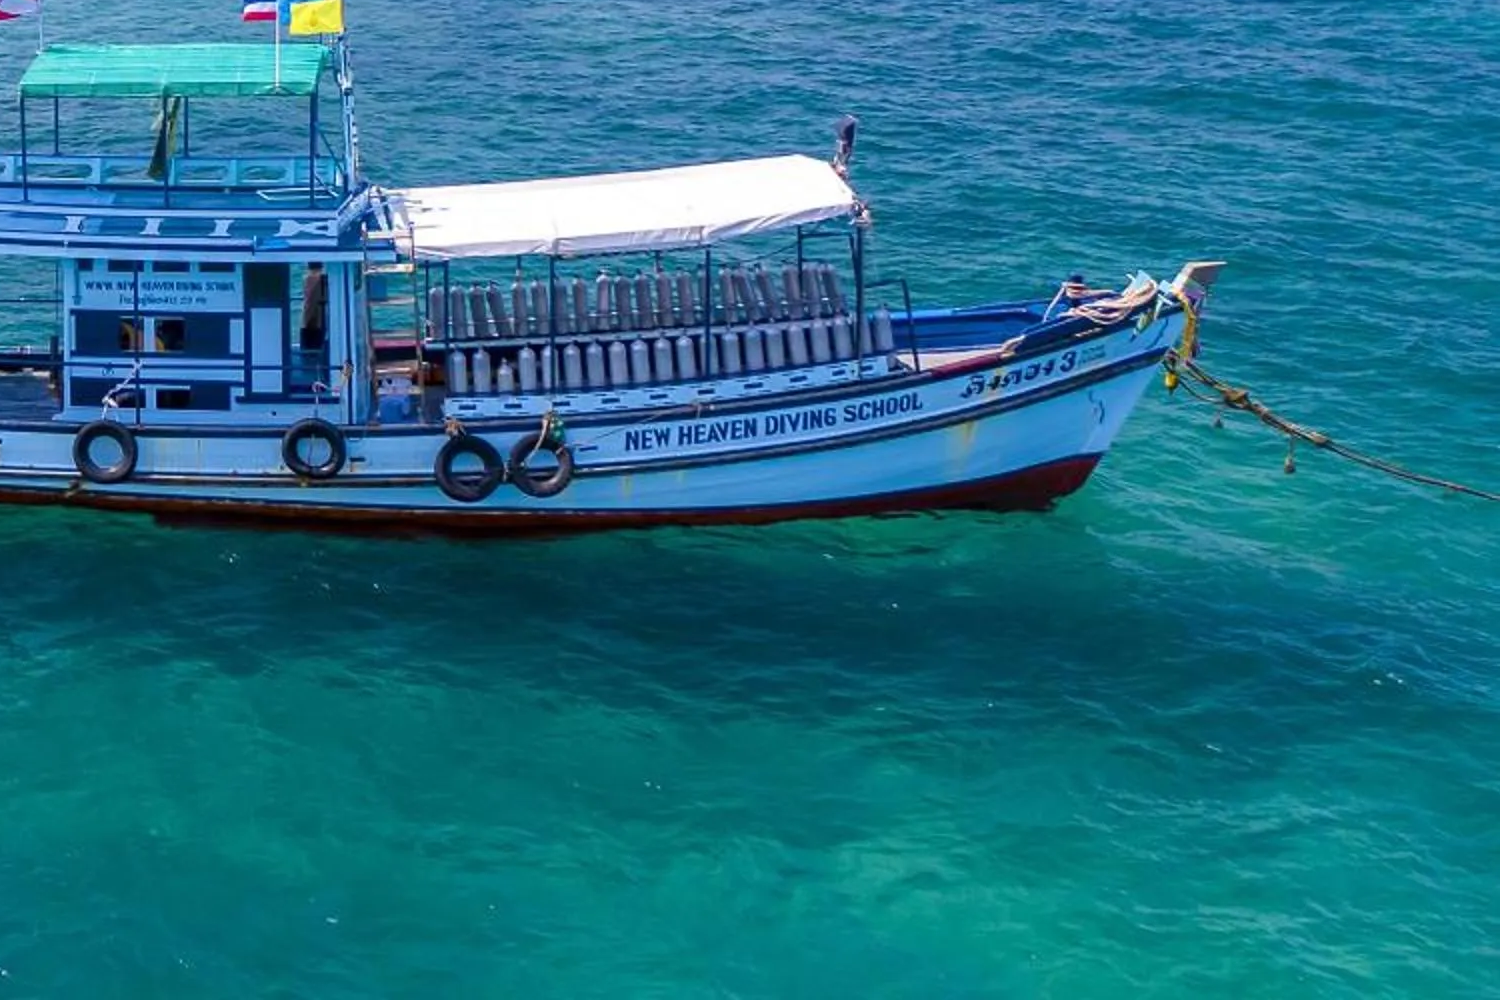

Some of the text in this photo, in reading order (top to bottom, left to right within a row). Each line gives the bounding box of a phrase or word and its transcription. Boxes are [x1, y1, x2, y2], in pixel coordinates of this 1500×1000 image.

[625, 392, 923, 451] NEW HEAVEN DIVING SCHOOL
